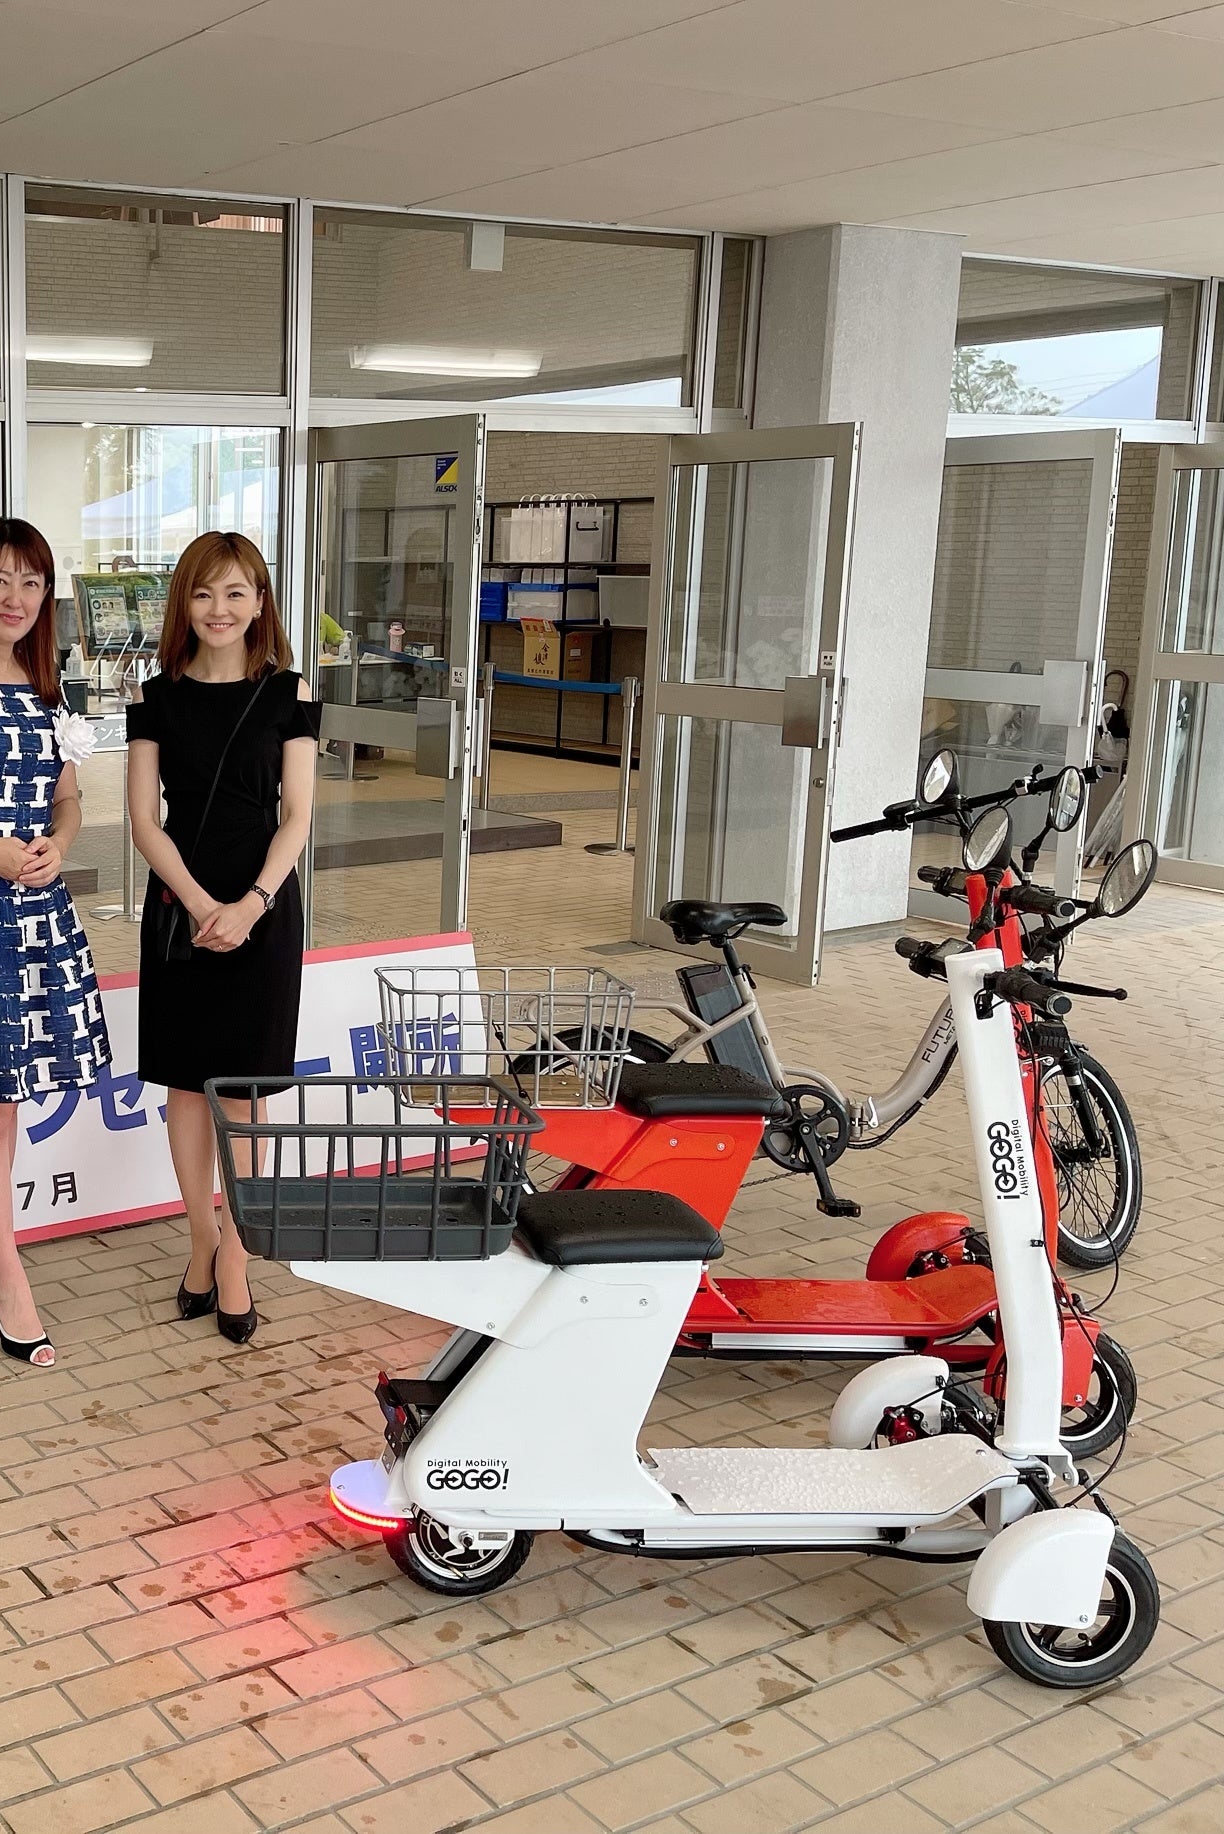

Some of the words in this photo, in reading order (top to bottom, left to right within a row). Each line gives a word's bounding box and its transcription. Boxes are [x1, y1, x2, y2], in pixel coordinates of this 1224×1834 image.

[921, 1003, 955, 1064] FUTUR
[1010, 1119, 1024, 1152] Digital
[987, 1121, 1021, 1200] GOGO!
[1016, 1155, 1030, 1197] Mobility
[426, 1468, 510, 1491] GOGO!
[427, 1458, 461, 1469] Digital
[465, 1458, 508, 1469] Mobility
